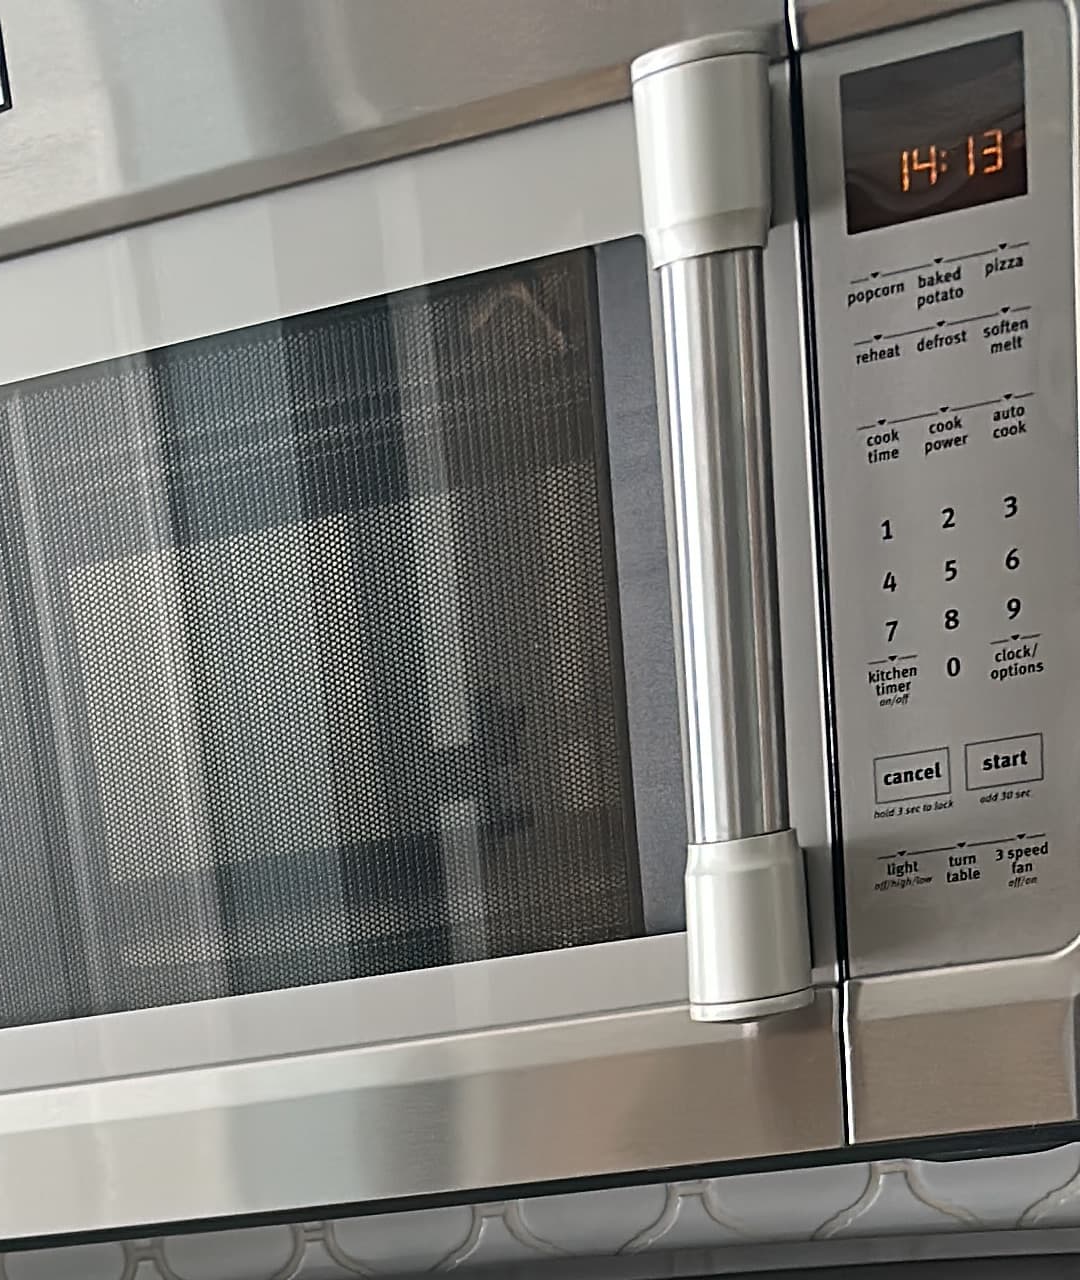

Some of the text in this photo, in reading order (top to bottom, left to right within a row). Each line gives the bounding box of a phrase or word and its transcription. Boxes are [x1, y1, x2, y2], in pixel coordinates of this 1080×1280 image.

[901, 129, 1003, 192] 14:13
[984, 255, 1024, 278] pizza
[917, 267, 961, 289] baked
[847, 282, 905, 307] popcorn
[917, 286, 964, 310] potato
[983, 318, 1029, 339] soften
[916, 330, 967, 353] defrost
[990, 336, 1023, 355] melt
[855, 345, 901, 366] reheat
[992, 405, 1025, 422] auto
[928, 416, 962, 435] cook
[992, 421, 1027, 439] cook
[866, 430, 899, 447] cook
[924, 433, 968, 455] power
[868, 447, 899, 464] time
[941, 507, 956, 528] 2
[1003, 496, 1018, 518] 3
[881, 519, 893, 540] 1
[1005, 548, 1020, 570] 6
[944, 559, 957, 581] 5
[883, 572, 897, 593] 4
[944, 609, 959, 629] 8
[1006, 598, 1021, 619] 9
[885, 620, 898, 642] 7
[995, 643, 1039, 663] clock/
[868, 665, 918, 684] kitchen
[947, 657, 961, 677] 0
[990, 661, 1044, 681] options
[875, 680, 912, 697] timer
[982, 750, 1028, 772] start
[883, 762, 942, 786] cancel
[949, 855, 976, 867] turn
[995, 842, 1049, 861] 3 speed
[887, 861, 918, 878] light
[946, 868, 981, 883] table
[1012, 861, 1033, 874] fan
